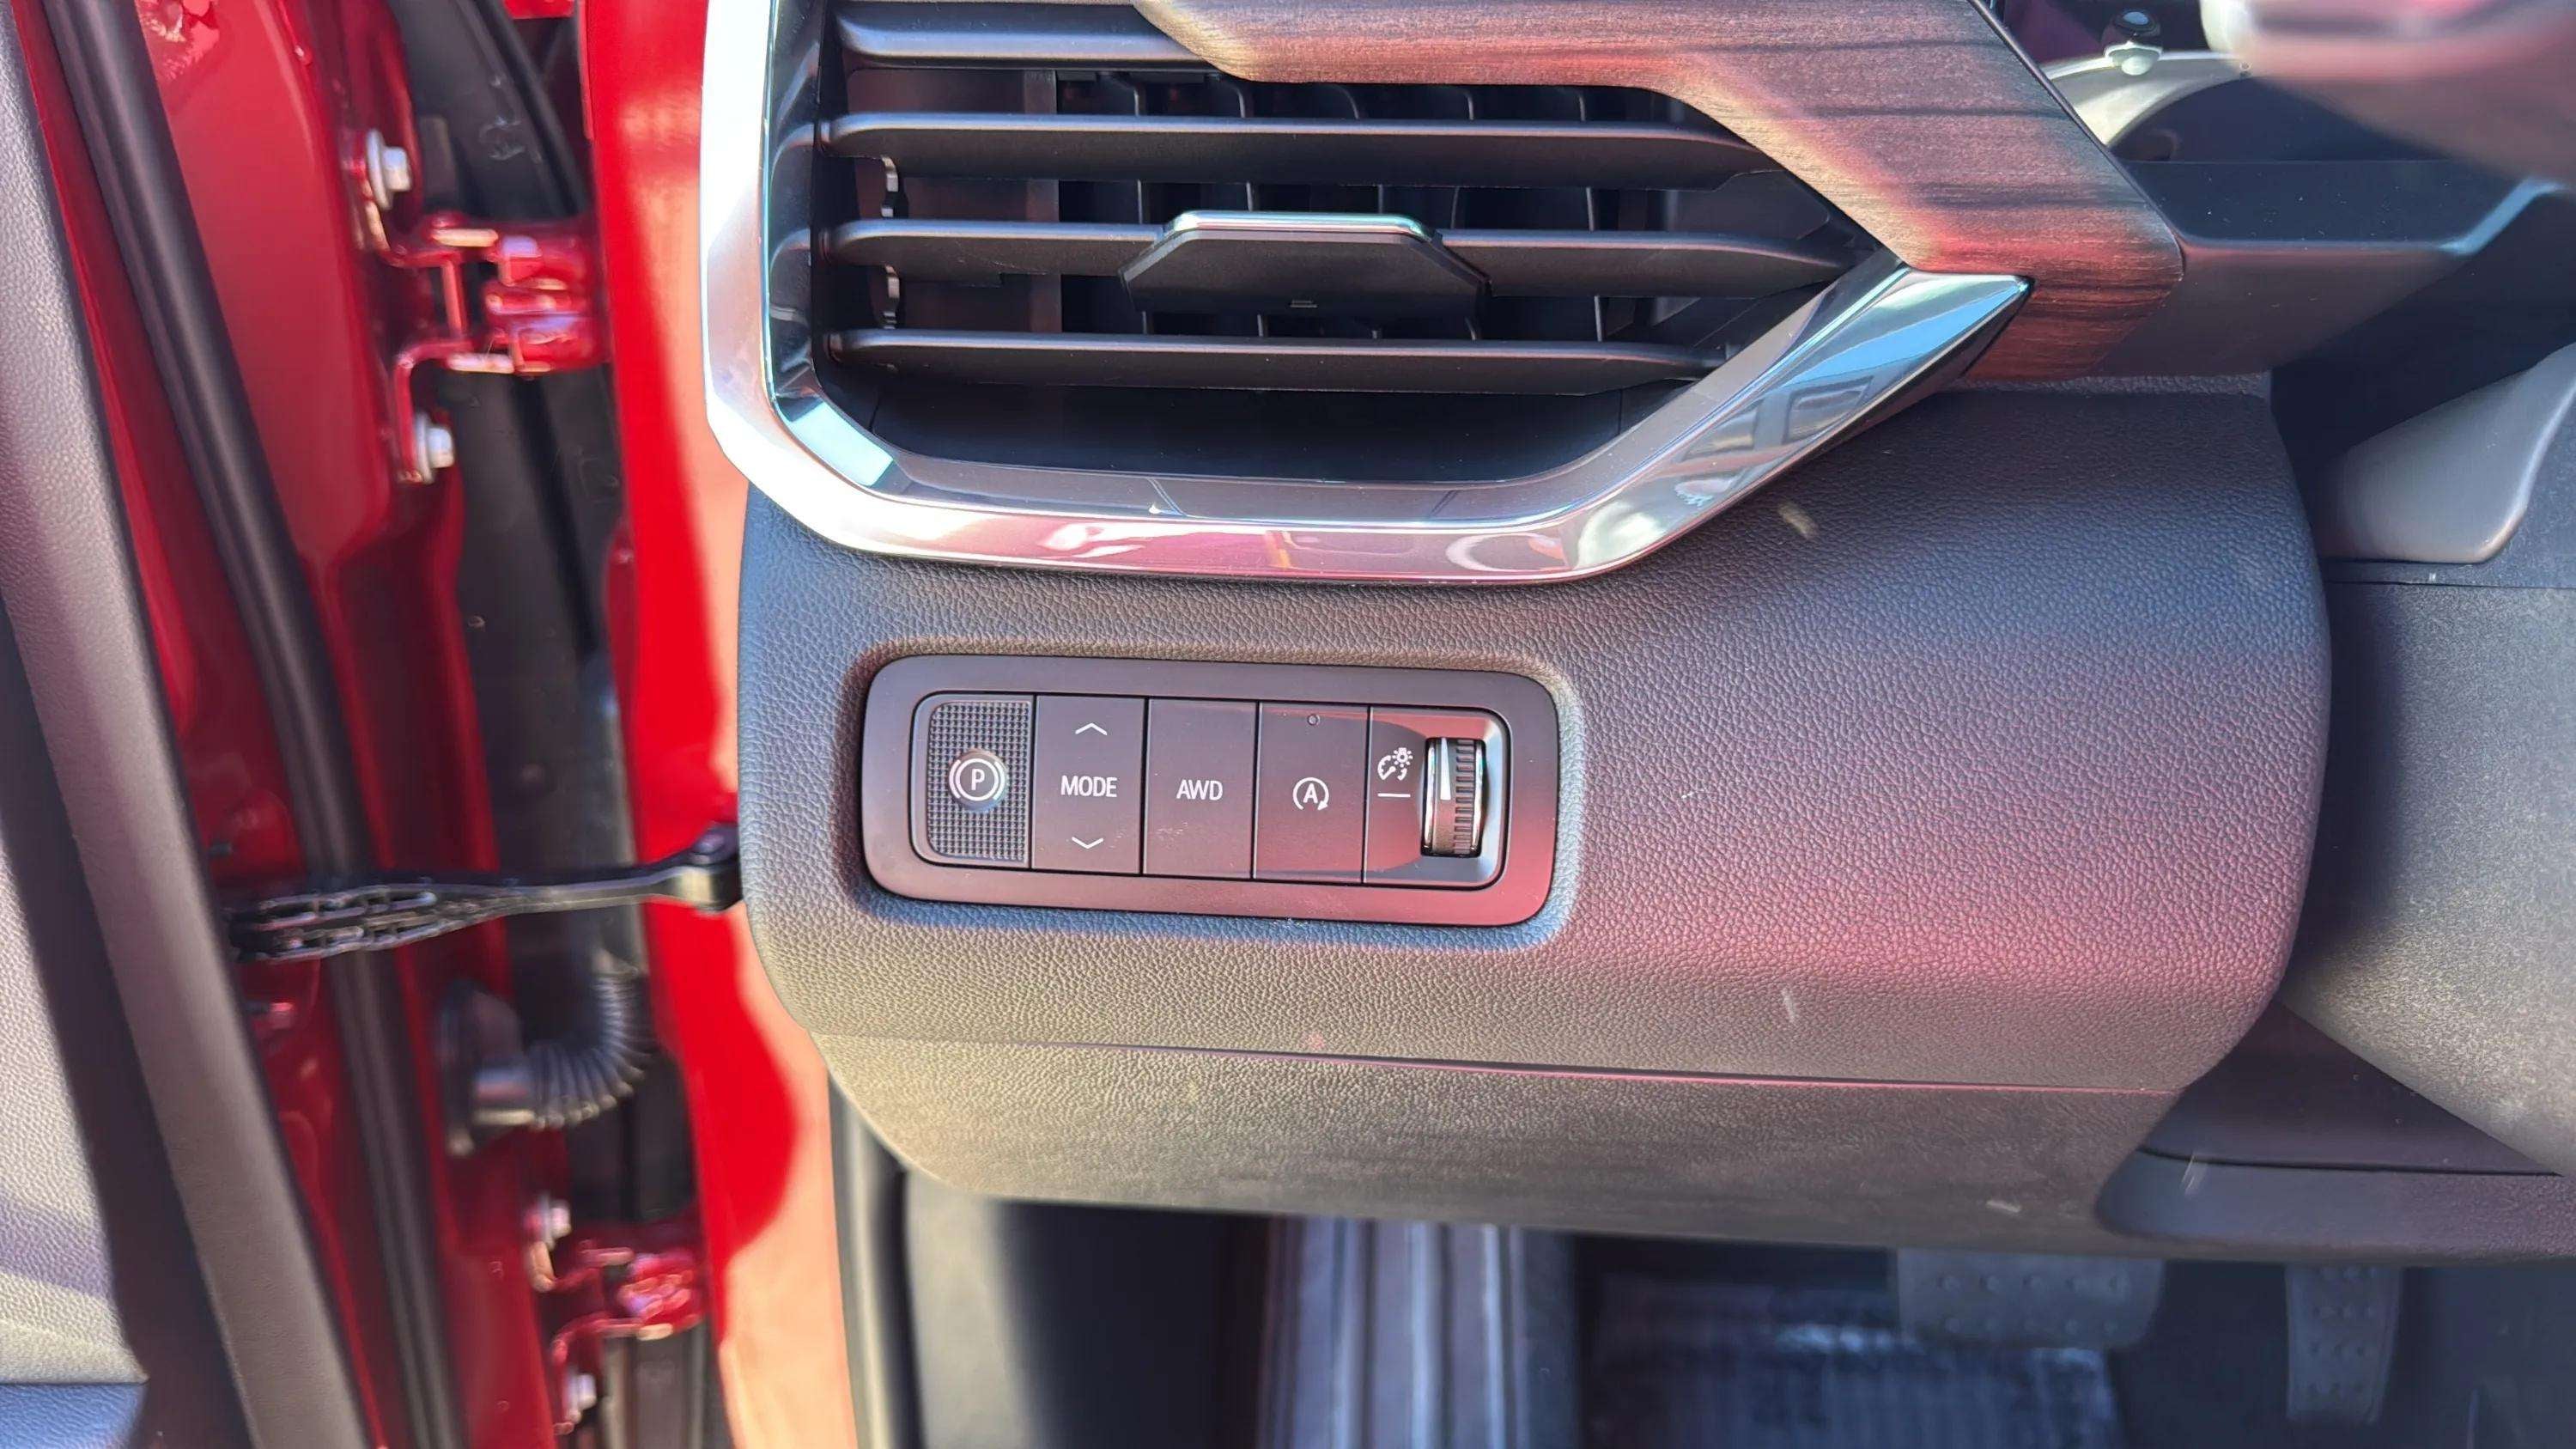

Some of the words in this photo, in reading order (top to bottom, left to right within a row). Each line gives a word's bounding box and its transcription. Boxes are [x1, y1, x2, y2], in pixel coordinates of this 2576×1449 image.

[970, 769, 986, 790] P
[1060, 776, 1118, 798] MODE
[1176, 780, 1224, 801] AWD
[1302, 783, 1319, 804] A
